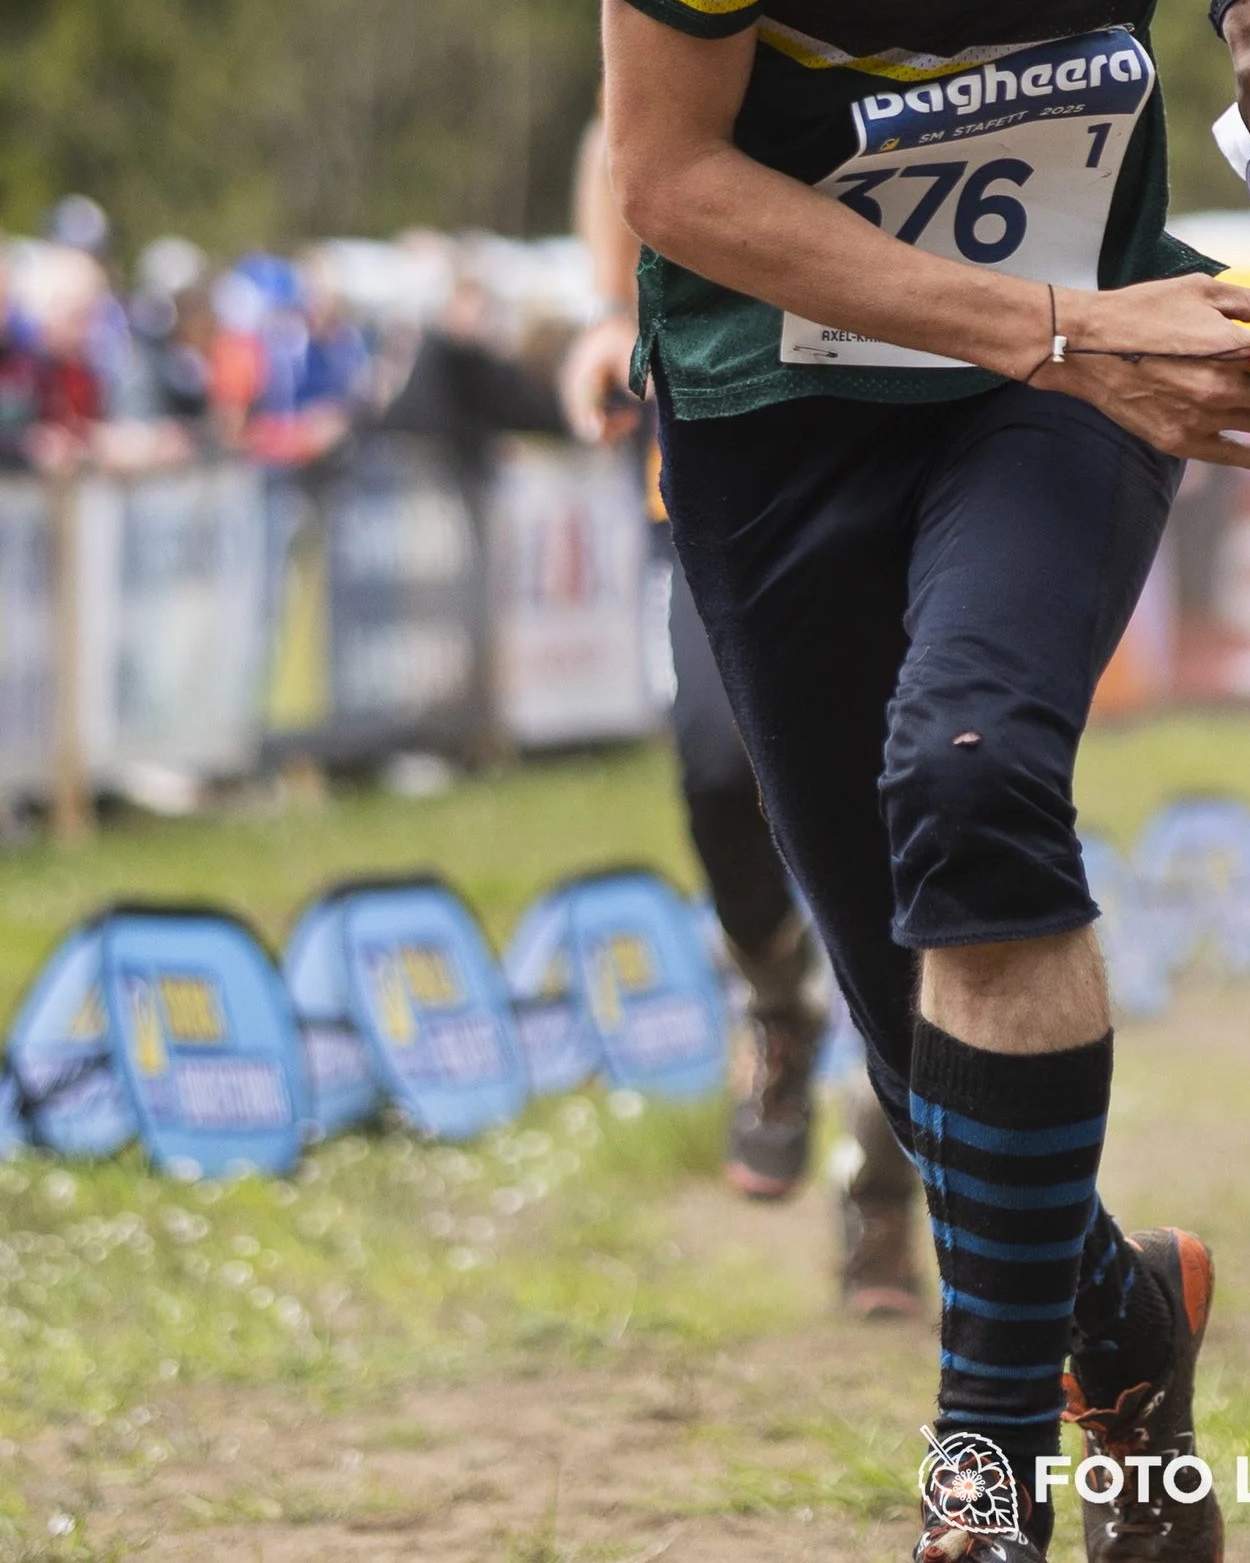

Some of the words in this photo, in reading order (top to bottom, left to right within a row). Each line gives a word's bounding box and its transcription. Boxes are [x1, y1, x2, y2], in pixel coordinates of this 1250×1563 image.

[918, 130, 945, 144] SM
[952, 110, 1029, 137] STAFETT
[1039, 103, 1086, 116] 2025
[1084, 122, 1112, 168] 1
[836, 158, 1034, 264] 376
